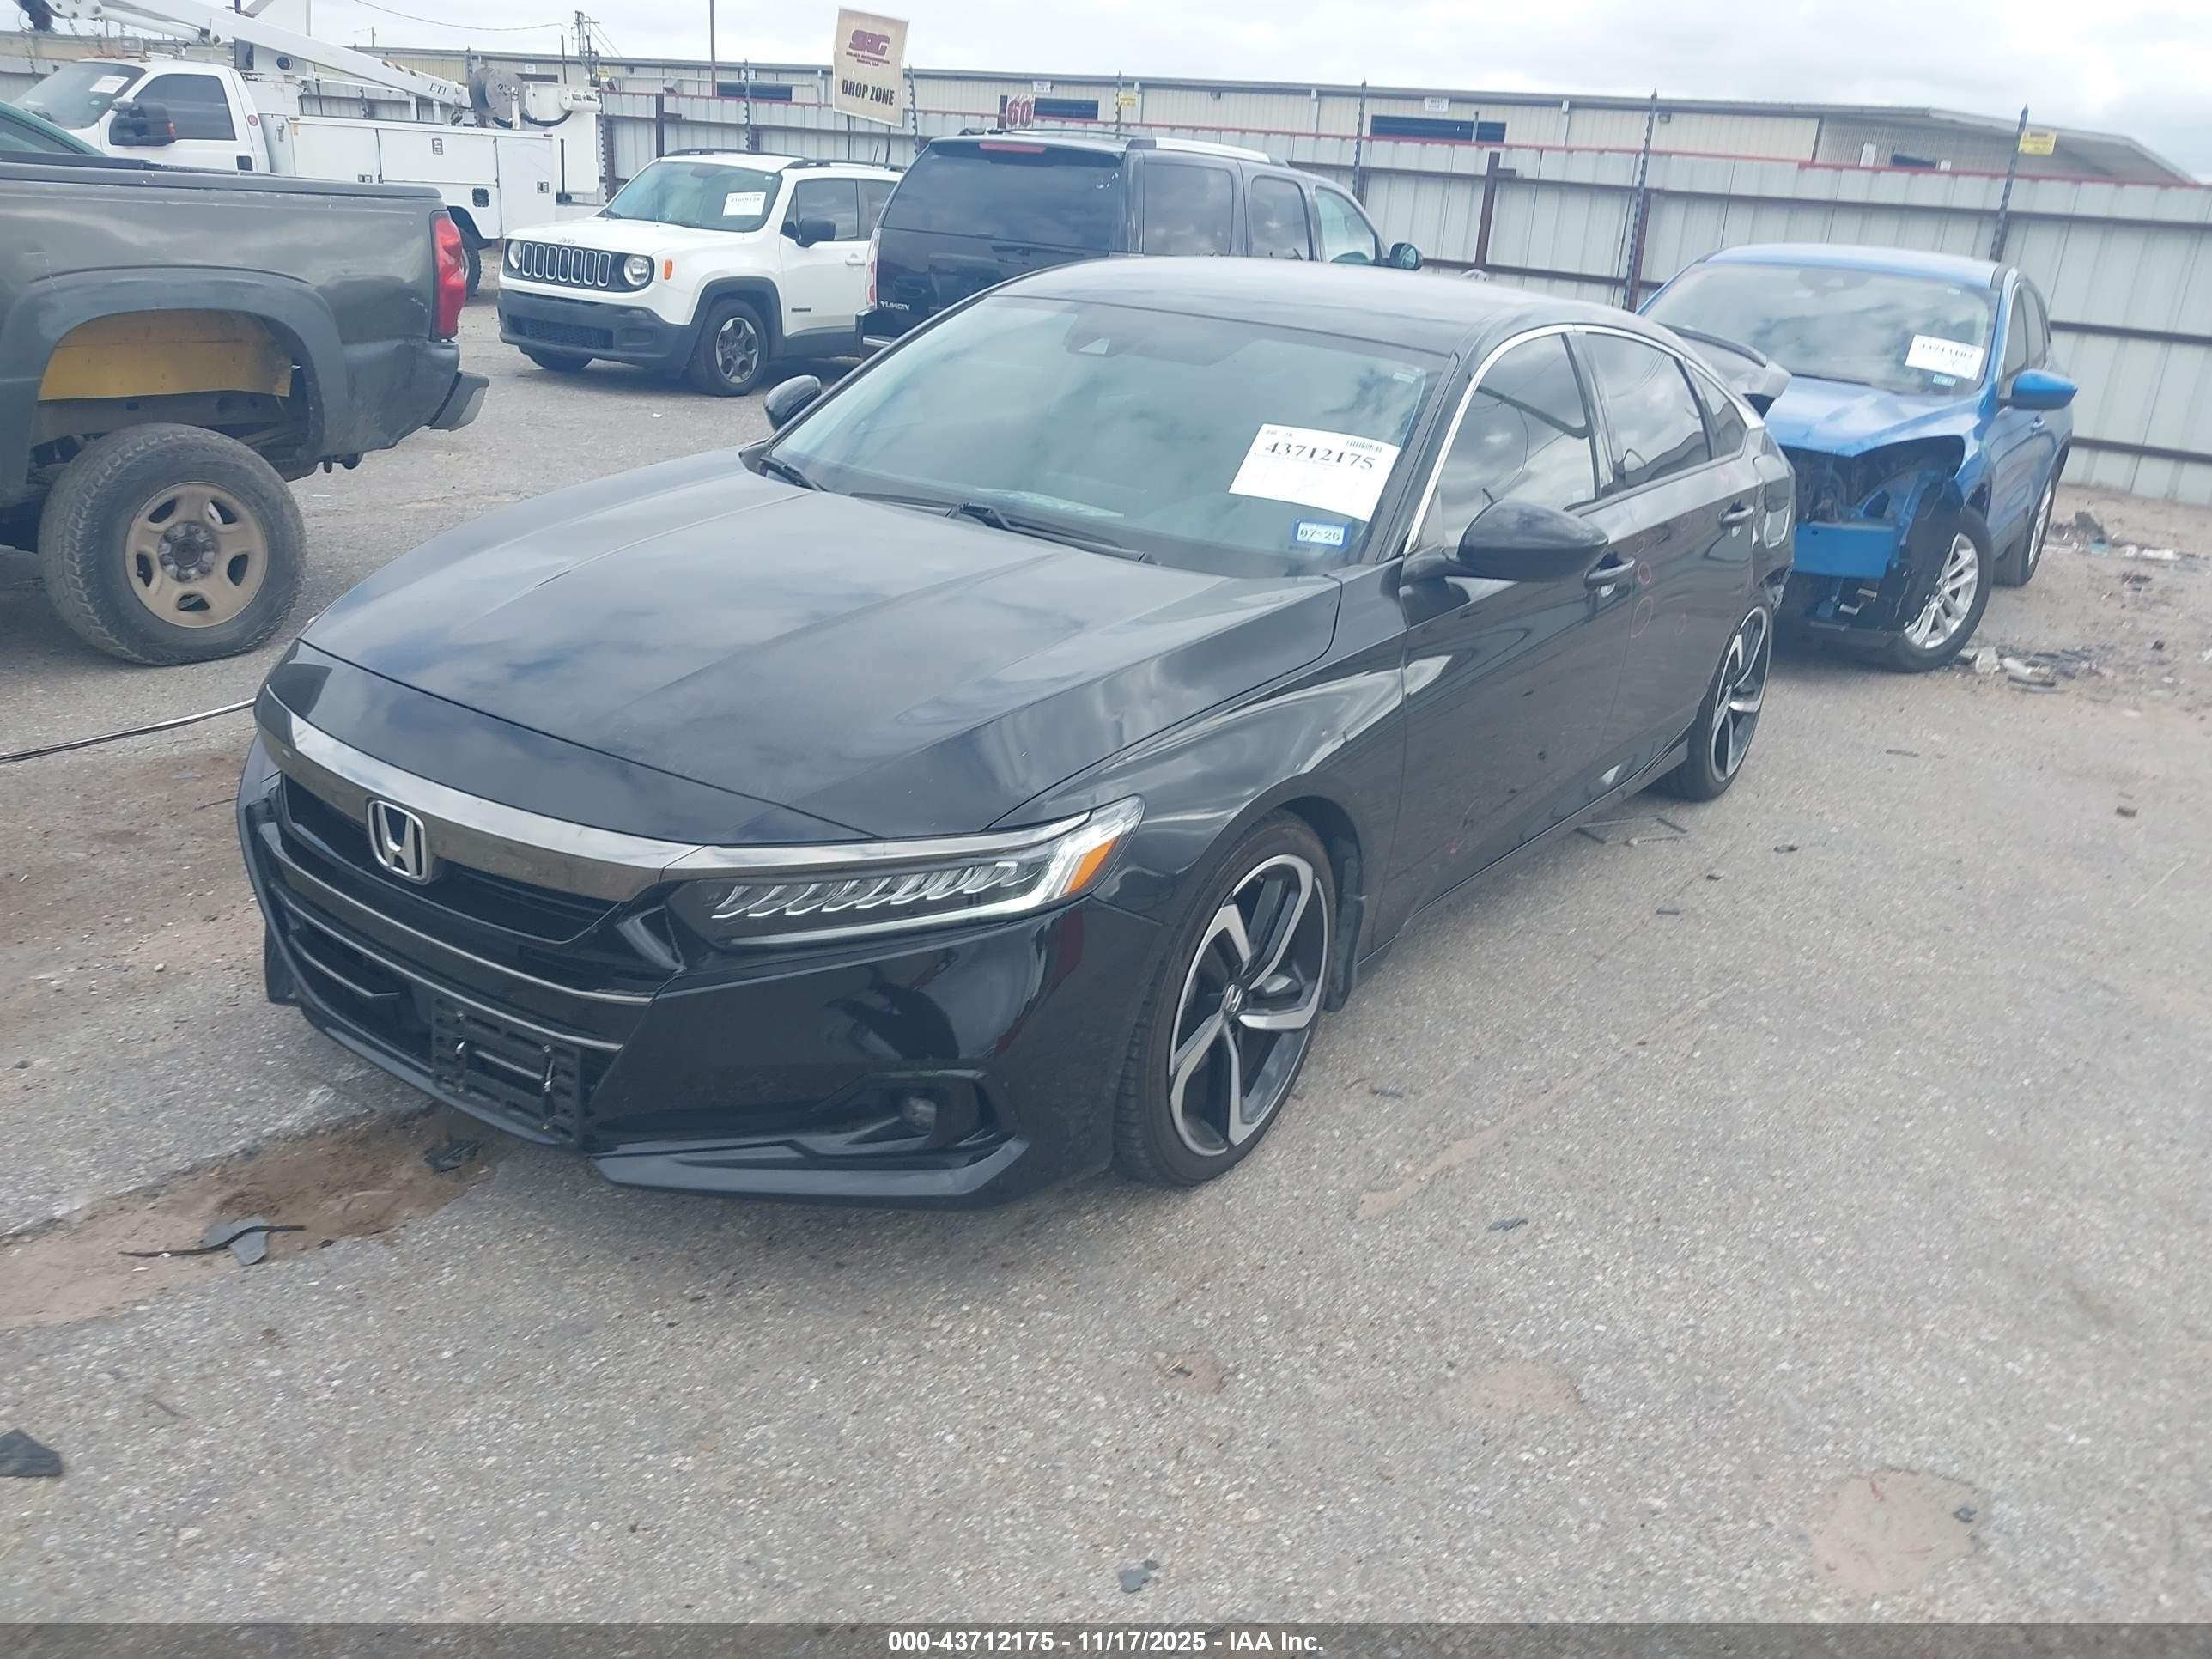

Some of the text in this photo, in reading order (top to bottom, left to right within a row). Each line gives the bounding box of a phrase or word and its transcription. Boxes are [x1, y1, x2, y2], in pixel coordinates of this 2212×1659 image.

[842, 79, 895, 106] DROP ZONE
[1007, 100, 1032, 126] 60
[1265, 441, 1376, 471] 43712175
